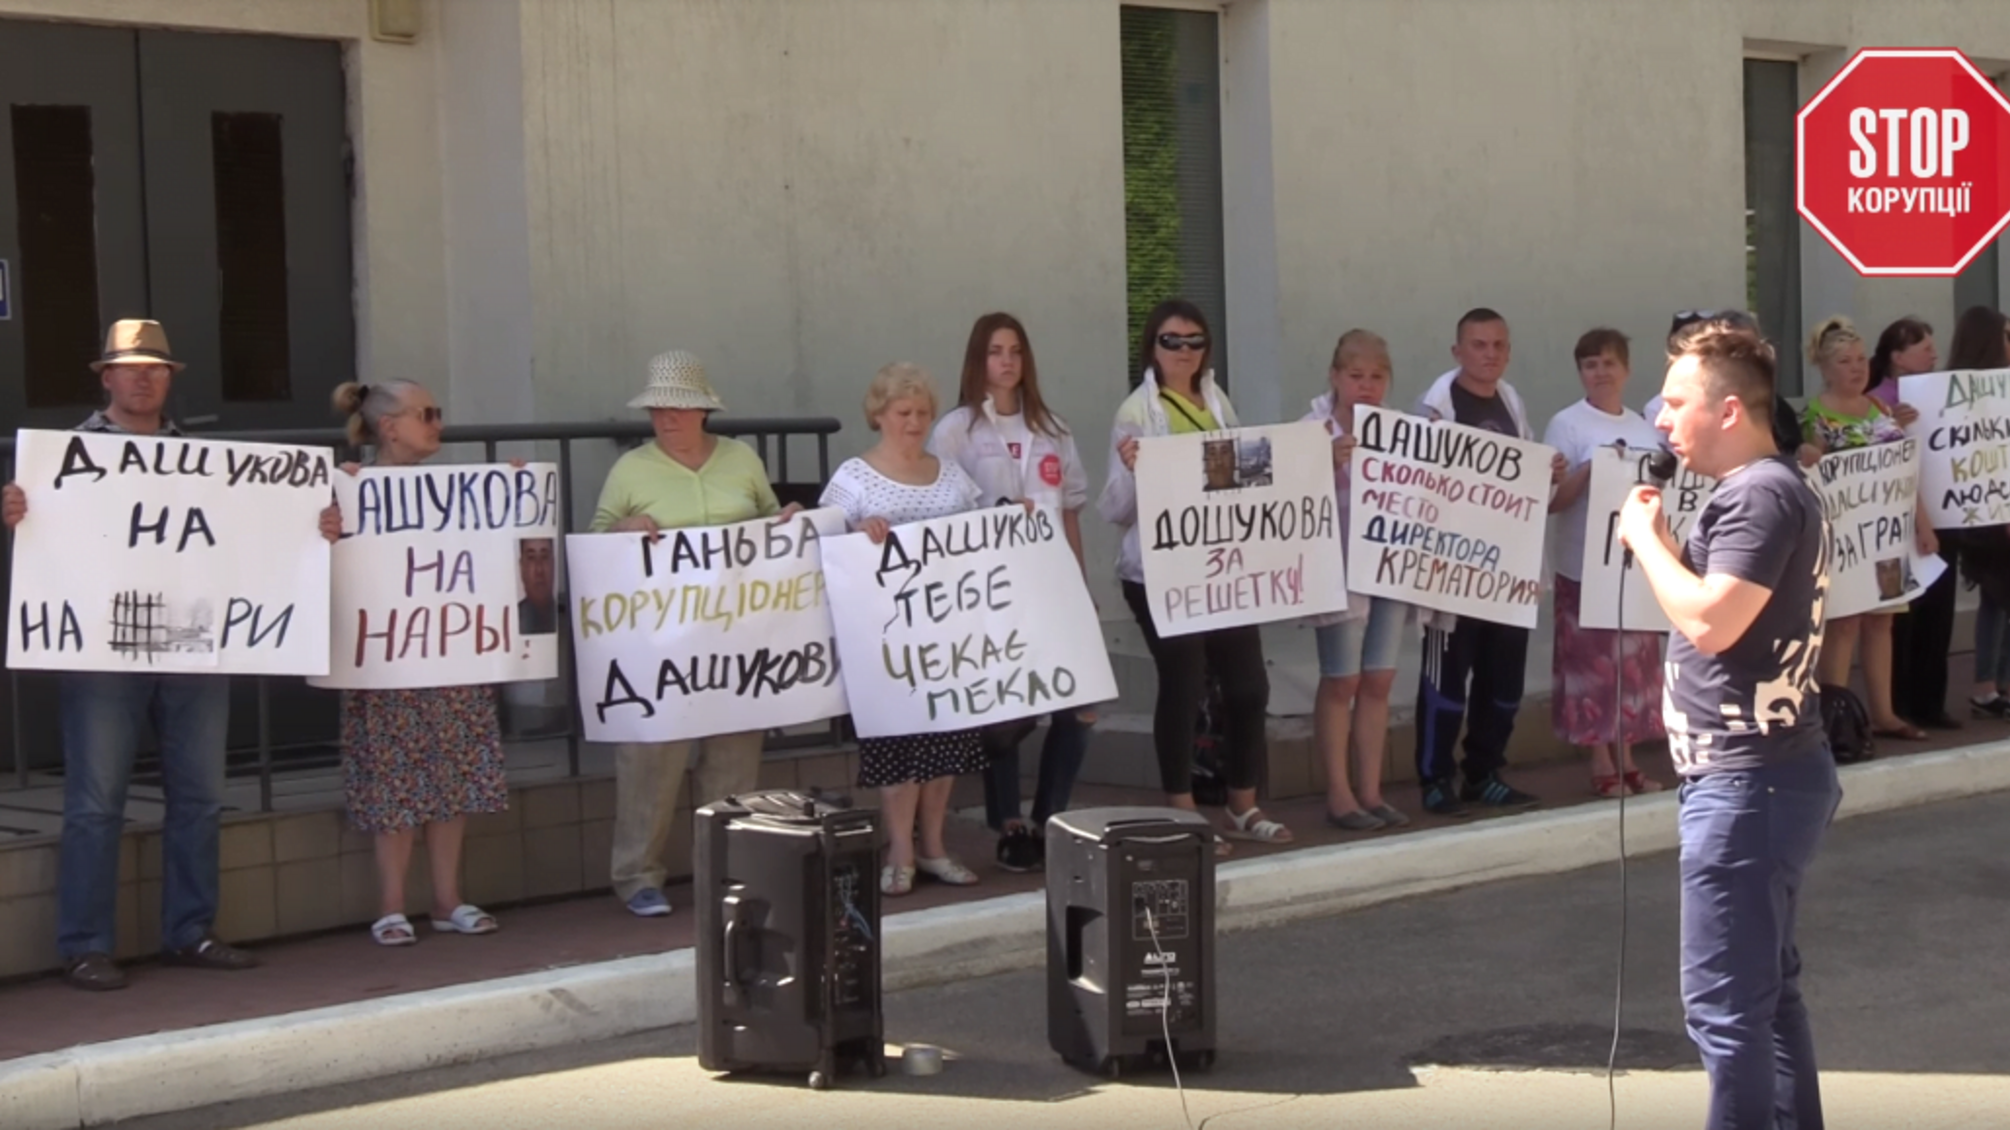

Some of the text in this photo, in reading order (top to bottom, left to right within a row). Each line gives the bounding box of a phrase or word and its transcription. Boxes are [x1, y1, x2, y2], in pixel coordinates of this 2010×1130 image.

[54, 436, 329, 489] ДАШУКОВА
[1359, 411, 1523, 481] ДАШУКОВ
[338, 470, 557, 539] АШУКОВА
[1361, 456, 1540, 522] СКОЛЬКО СТОИТ
[1362, 488, 1439, 524] МЕСТО
[128, 501, 216, 552] НА
[641, 517, 820, 577] ГАНЬБА
[876, 510, 1054, 588] ДАШУКОВ
[1152, 495, 1332, 550] ДОШУКОВА
[1361, 514, 1501, 572] ДИРЕКТОРА
[406, 546, 475, 597] НА
[1165, 553, 1304, 623] РЕШЕТКУ!
[1205, 547, 1244, 579] ЗА
[1375, 546, 1541, 606] КРЕМАТОРИЯ
[20, 597, 295, 652] НА РИ
[894, 564, 1012, 627] ТЕБЕ
[882, 629, 1028, 688] ЧЕКАЄ
[926, 666, 1076, 721] ПЕКЛО
